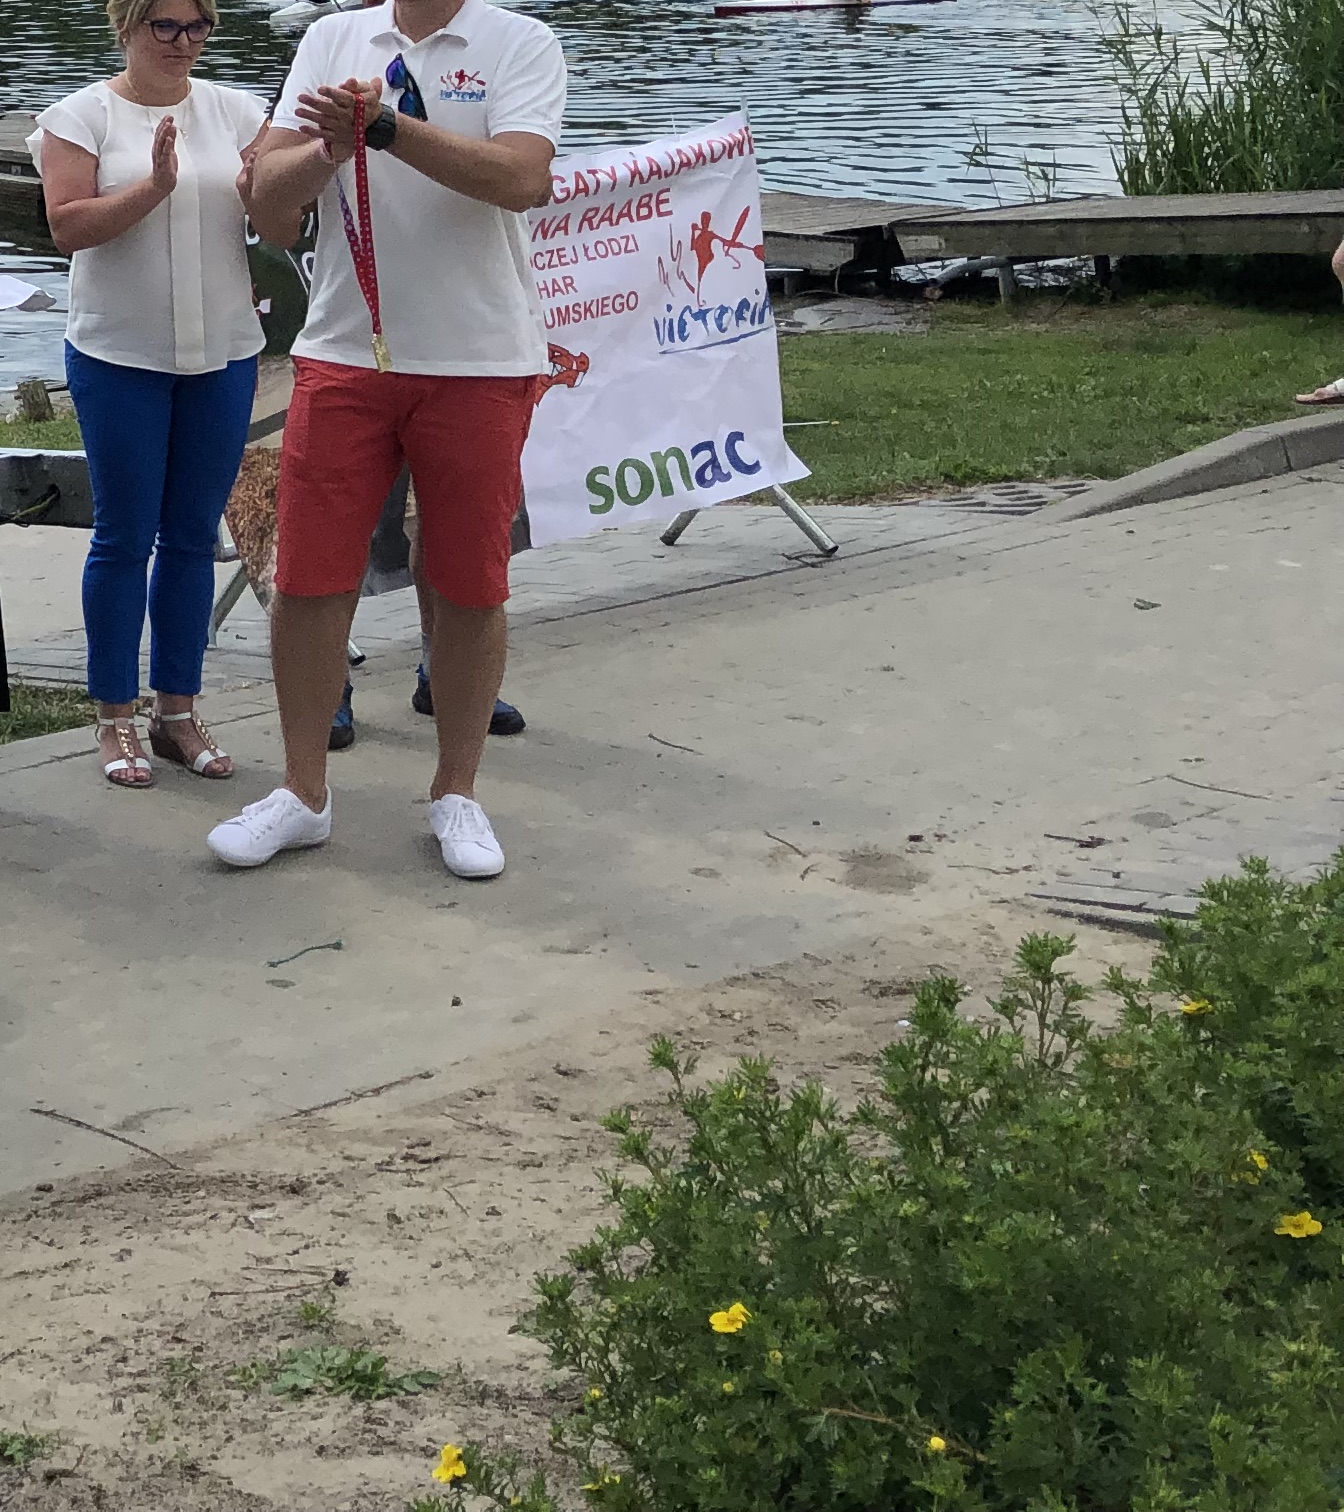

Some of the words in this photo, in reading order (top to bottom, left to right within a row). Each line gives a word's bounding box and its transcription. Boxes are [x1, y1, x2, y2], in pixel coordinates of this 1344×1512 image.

[552, 165, 618, 205] GATY
[577, 188, 673, 233] RAABE
[583, 234, 640, 261] ŁODZI
[543, 291, 639, 330] UMSKIEGO
[585, 430, 762, 515] sonac
